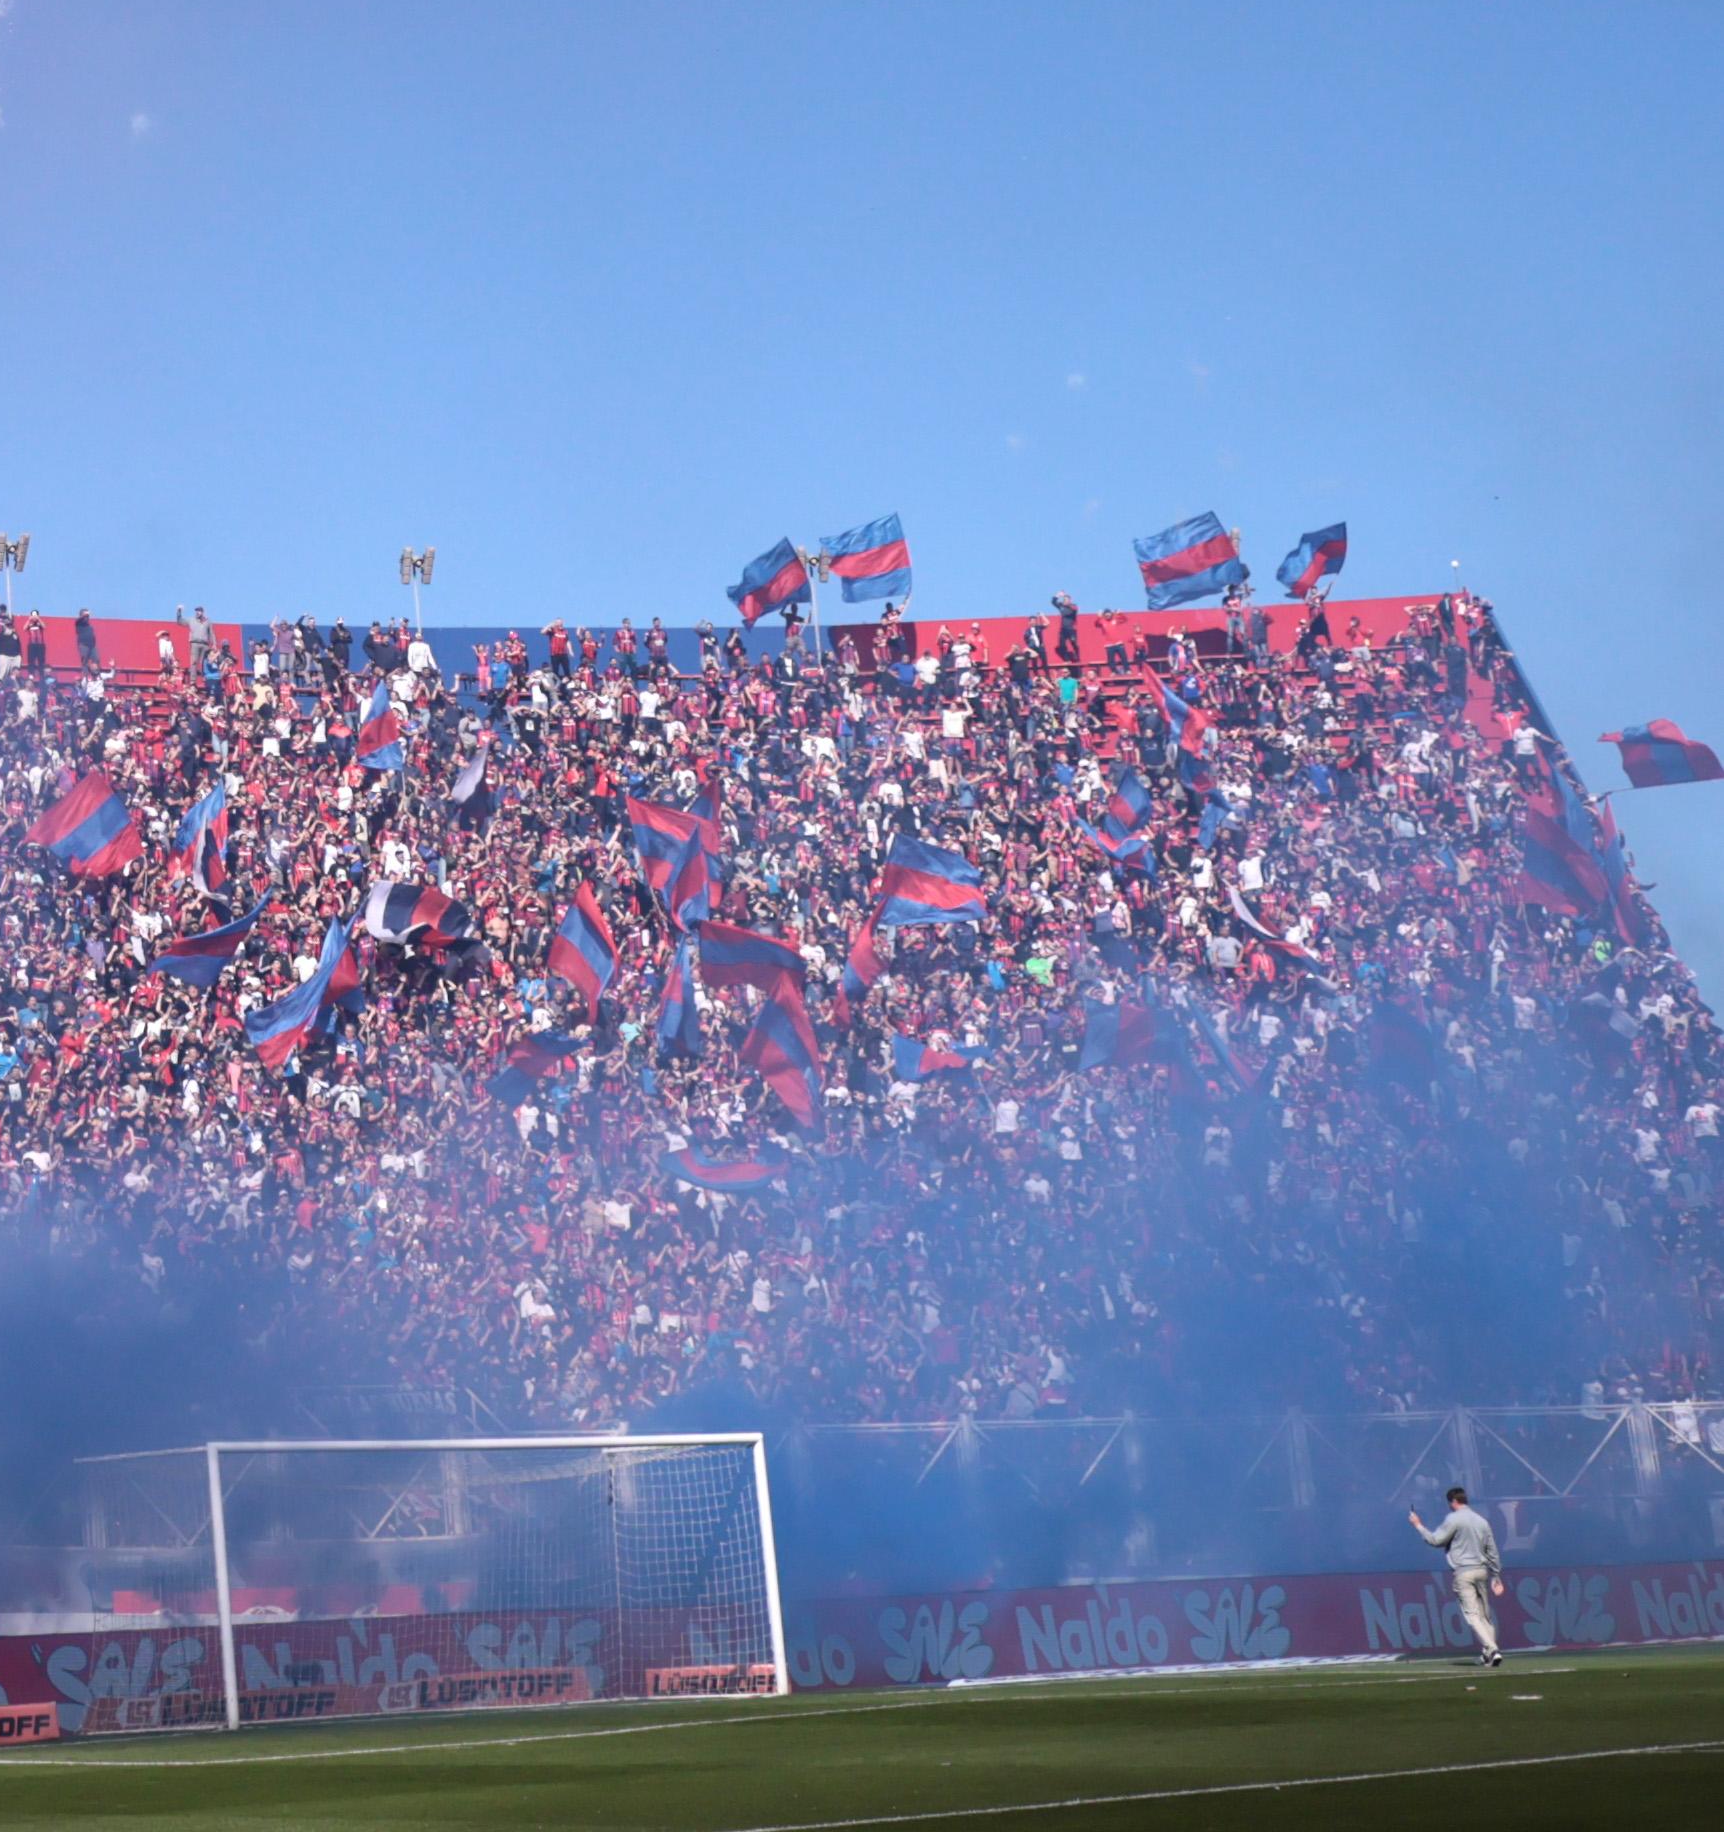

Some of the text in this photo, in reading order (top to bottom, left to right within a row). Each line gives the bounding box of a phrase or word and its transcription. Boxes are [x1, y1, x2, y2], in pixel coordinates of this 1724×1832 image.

[687, 1616, 856, 1688] Ndo
[878, 1600, 995, 1683] SALE
[1015, 1584, 1170, 1671] Naldo
[1182, 1583, 1292, 1662] SALE
[1360, 1571, 1498, 1651] Nald
[1516, 1572, 1616, 1646] SALE
